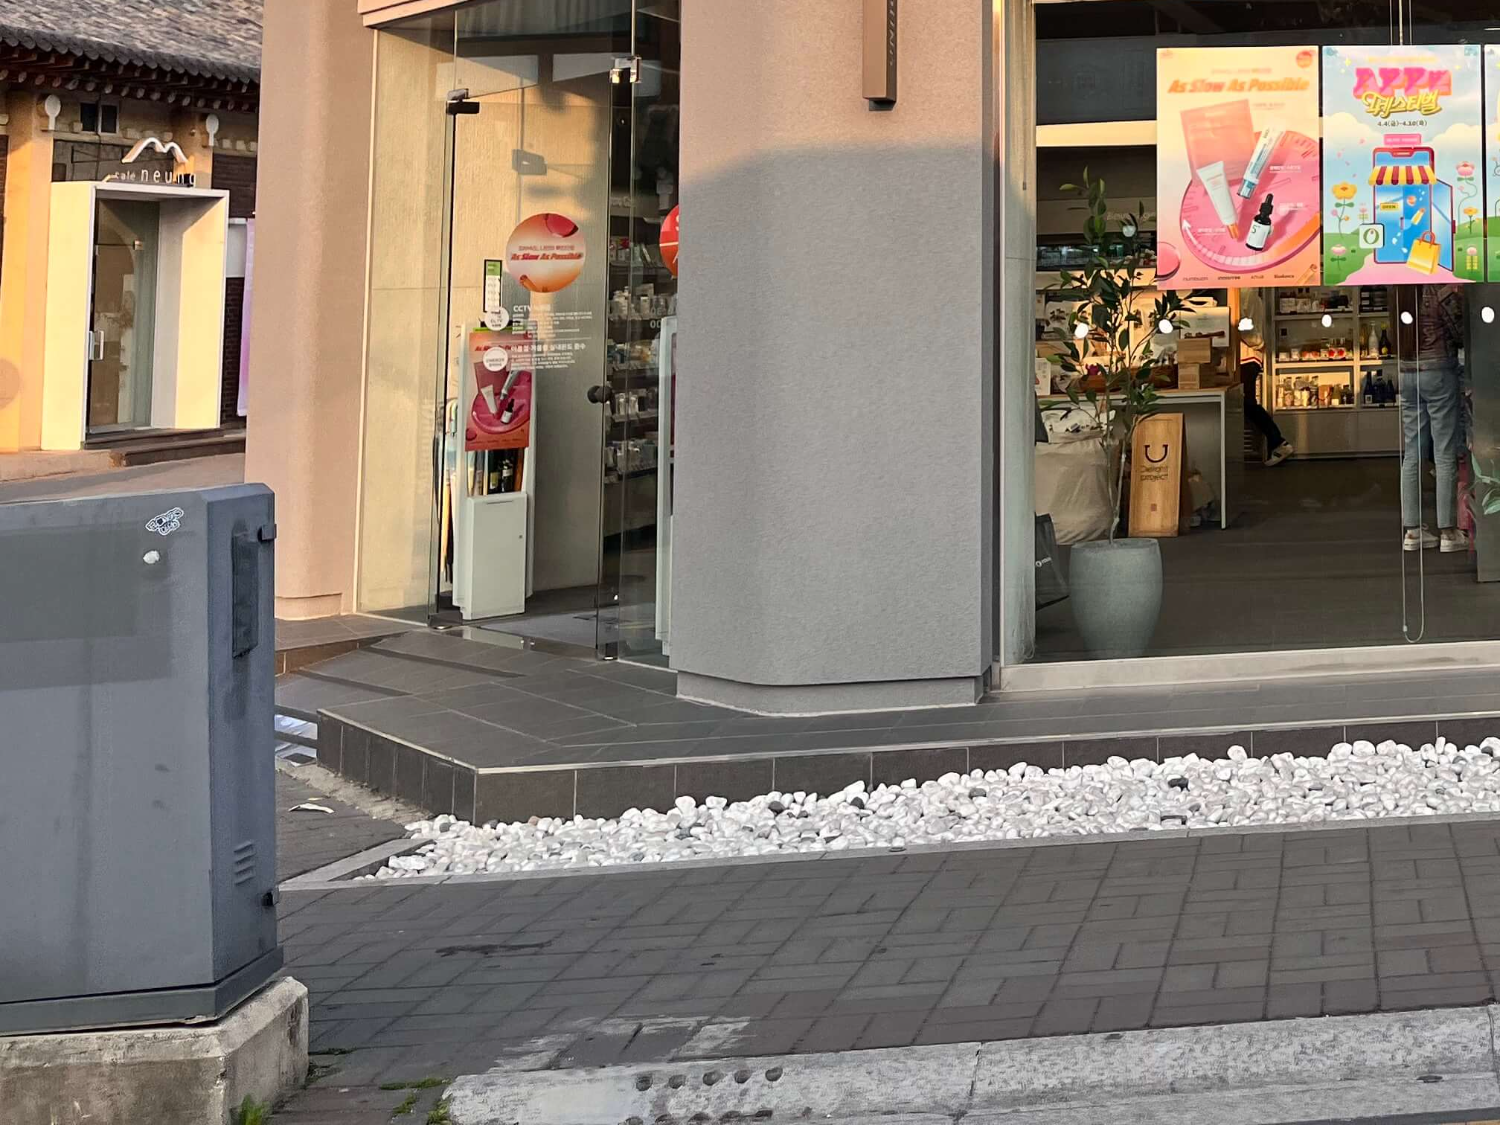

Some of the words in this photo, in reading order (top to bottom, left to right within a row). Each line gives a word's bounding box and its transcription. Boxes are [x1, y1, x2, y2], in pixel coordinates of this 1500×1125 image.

[1167, 79, 1186, 93] As
[1188, 78, 1225, 93] Slow
[1226, 78, 1245, 92] As
[1247, 77, 1310, 92] Possible
[1361, 89, 1442, 119] 페스티벌
